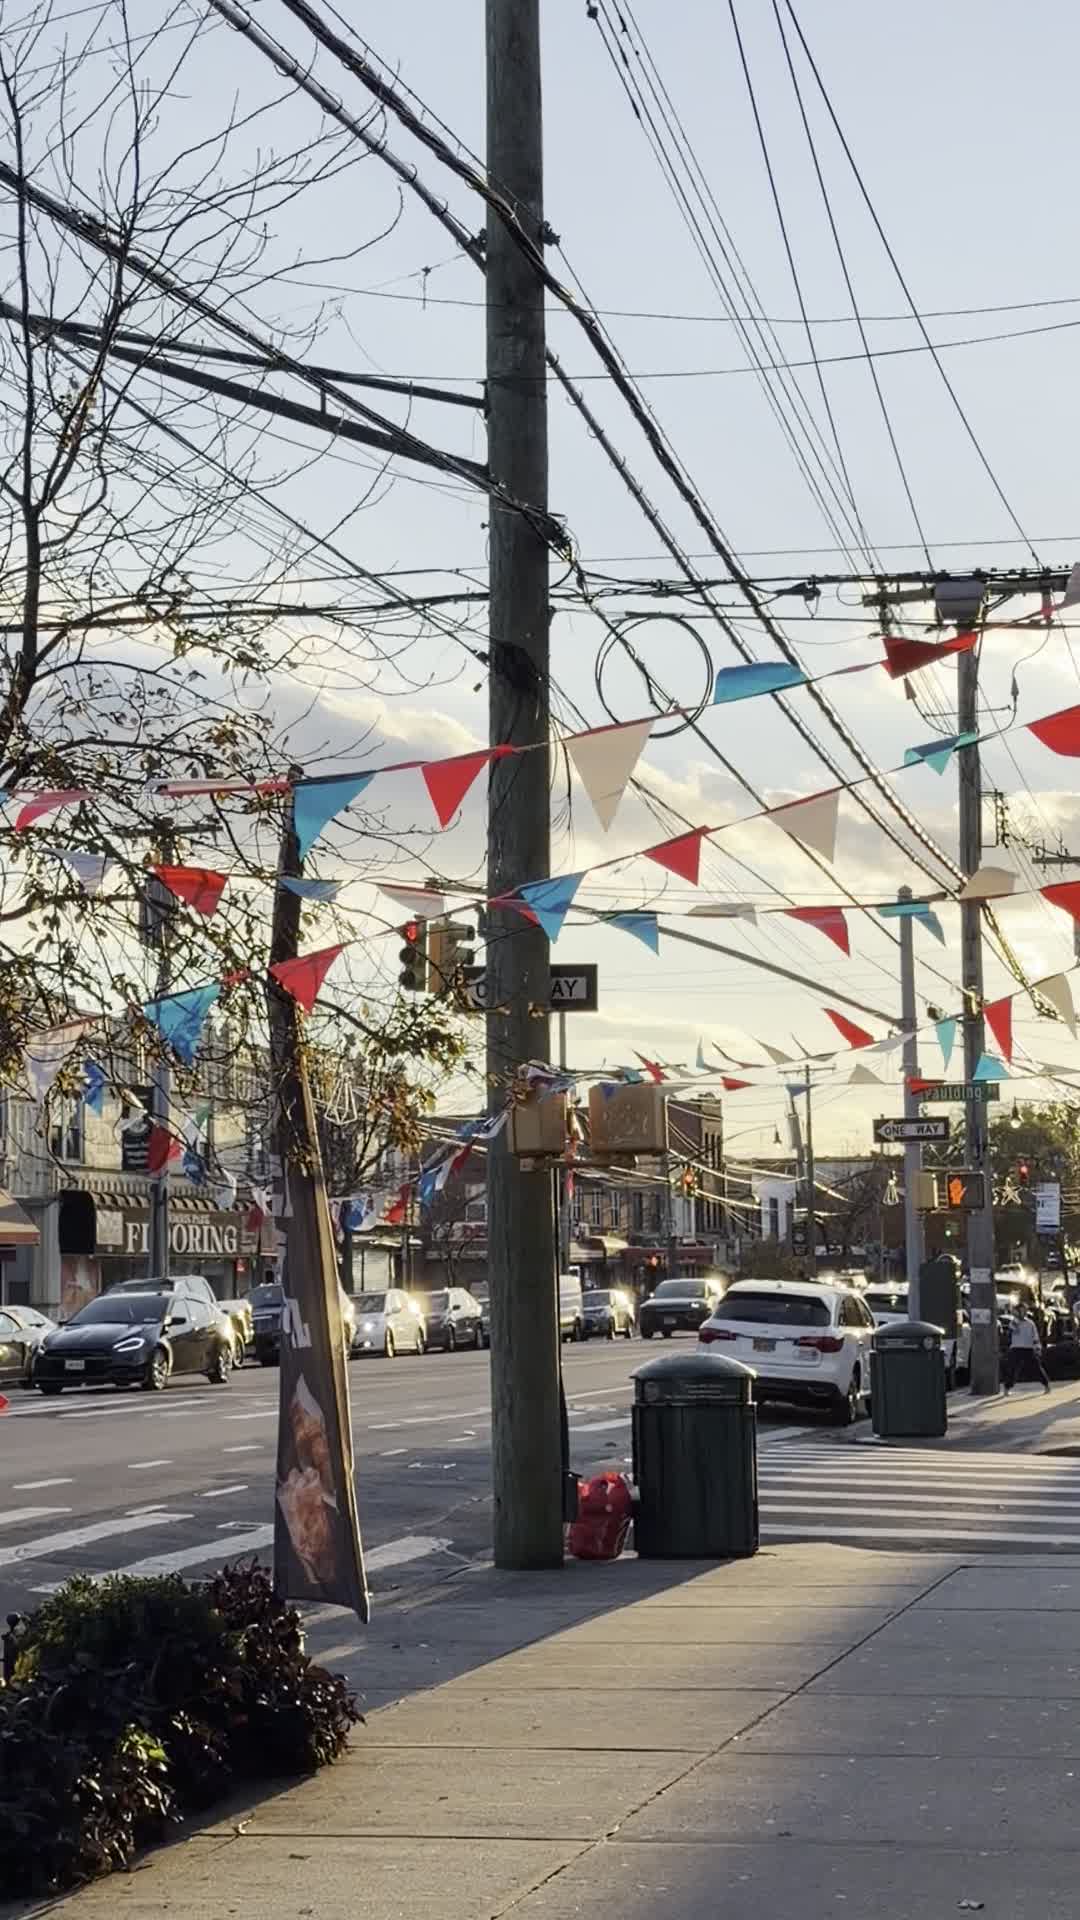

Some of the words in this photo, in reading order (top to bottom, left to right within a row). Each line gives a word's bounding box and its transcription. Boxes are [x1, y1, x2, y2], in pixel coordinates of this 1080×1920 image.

[551, 979, 579, 998] AY
[883, 1125, 905, 1136] ONE
[915, 1124, 939, 1135] WAY
